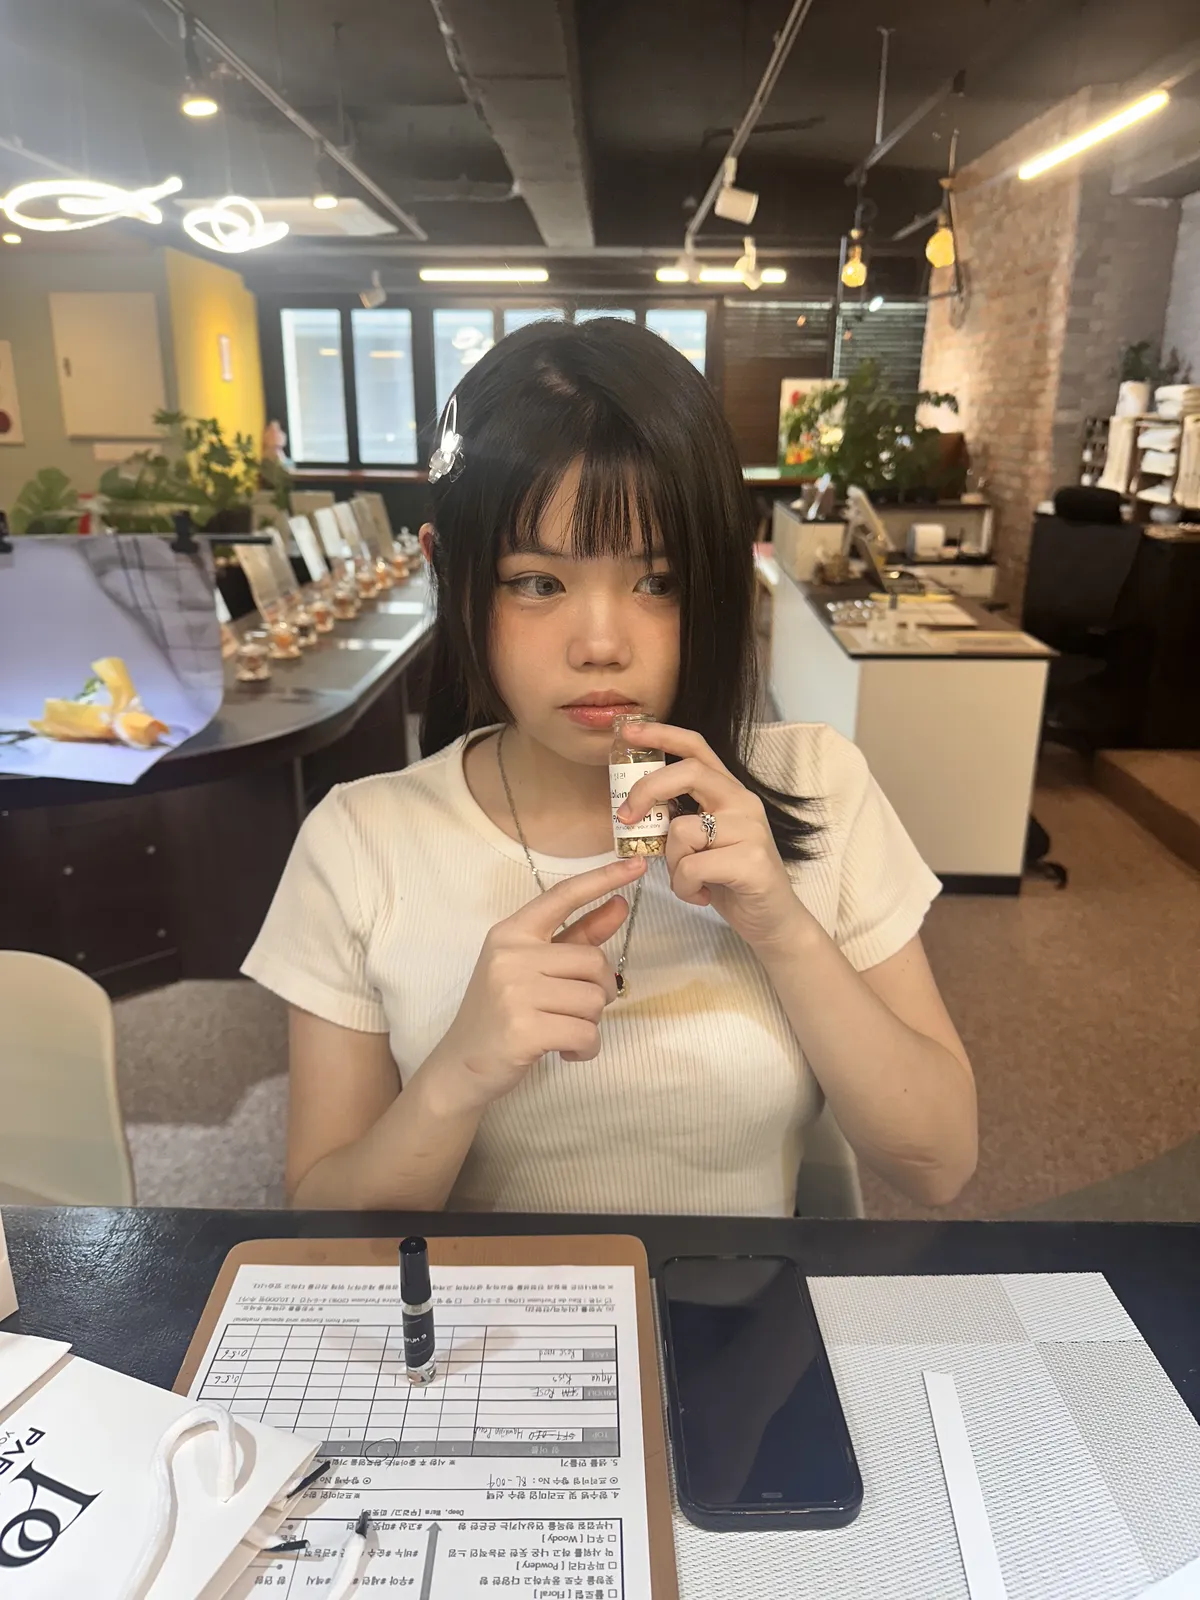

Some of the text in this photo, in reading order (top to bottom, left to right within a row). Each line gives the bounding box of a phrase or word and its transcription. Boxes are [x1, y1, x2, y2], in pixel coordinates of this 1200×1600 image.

[560, 1458, 618, 1466] 5. 샘플 만들기
[538, 1476, 607, 1485] 프리미엄 향수 No
[486, 1490, 619, 1500] 4. 향수병 및 프리미엄 향수 선택
[445, 1508, 464, 1516] Deep,
[398, 1522, 422, 1530] #고상
[458, 1522, 466, 1530] 향
[470, 1522, 496, 1530] 은은한
[500, 1522, 544, 1530] 연상시키는
[548, 1534, 604, 1544] 우디 Woody
[368, 1548, 391, 1558] #순수
[395, 1548, 418, 1558] #비누
[448, 1548, 614, 1558] 막 샤워를 하고 나온 듯한 관능적인 느낌
[522, 1560, 604, 1570] 파우더리 Powdery
[362, 1576, 386, 1585] #세련
[390, 1576, 414, 1585] #우아
[480, 1575, 614, 1586] 꽃향을 주로 풍부하고 다양한 향
[540, 1590, 604, 1600] 플로럴 Floral
